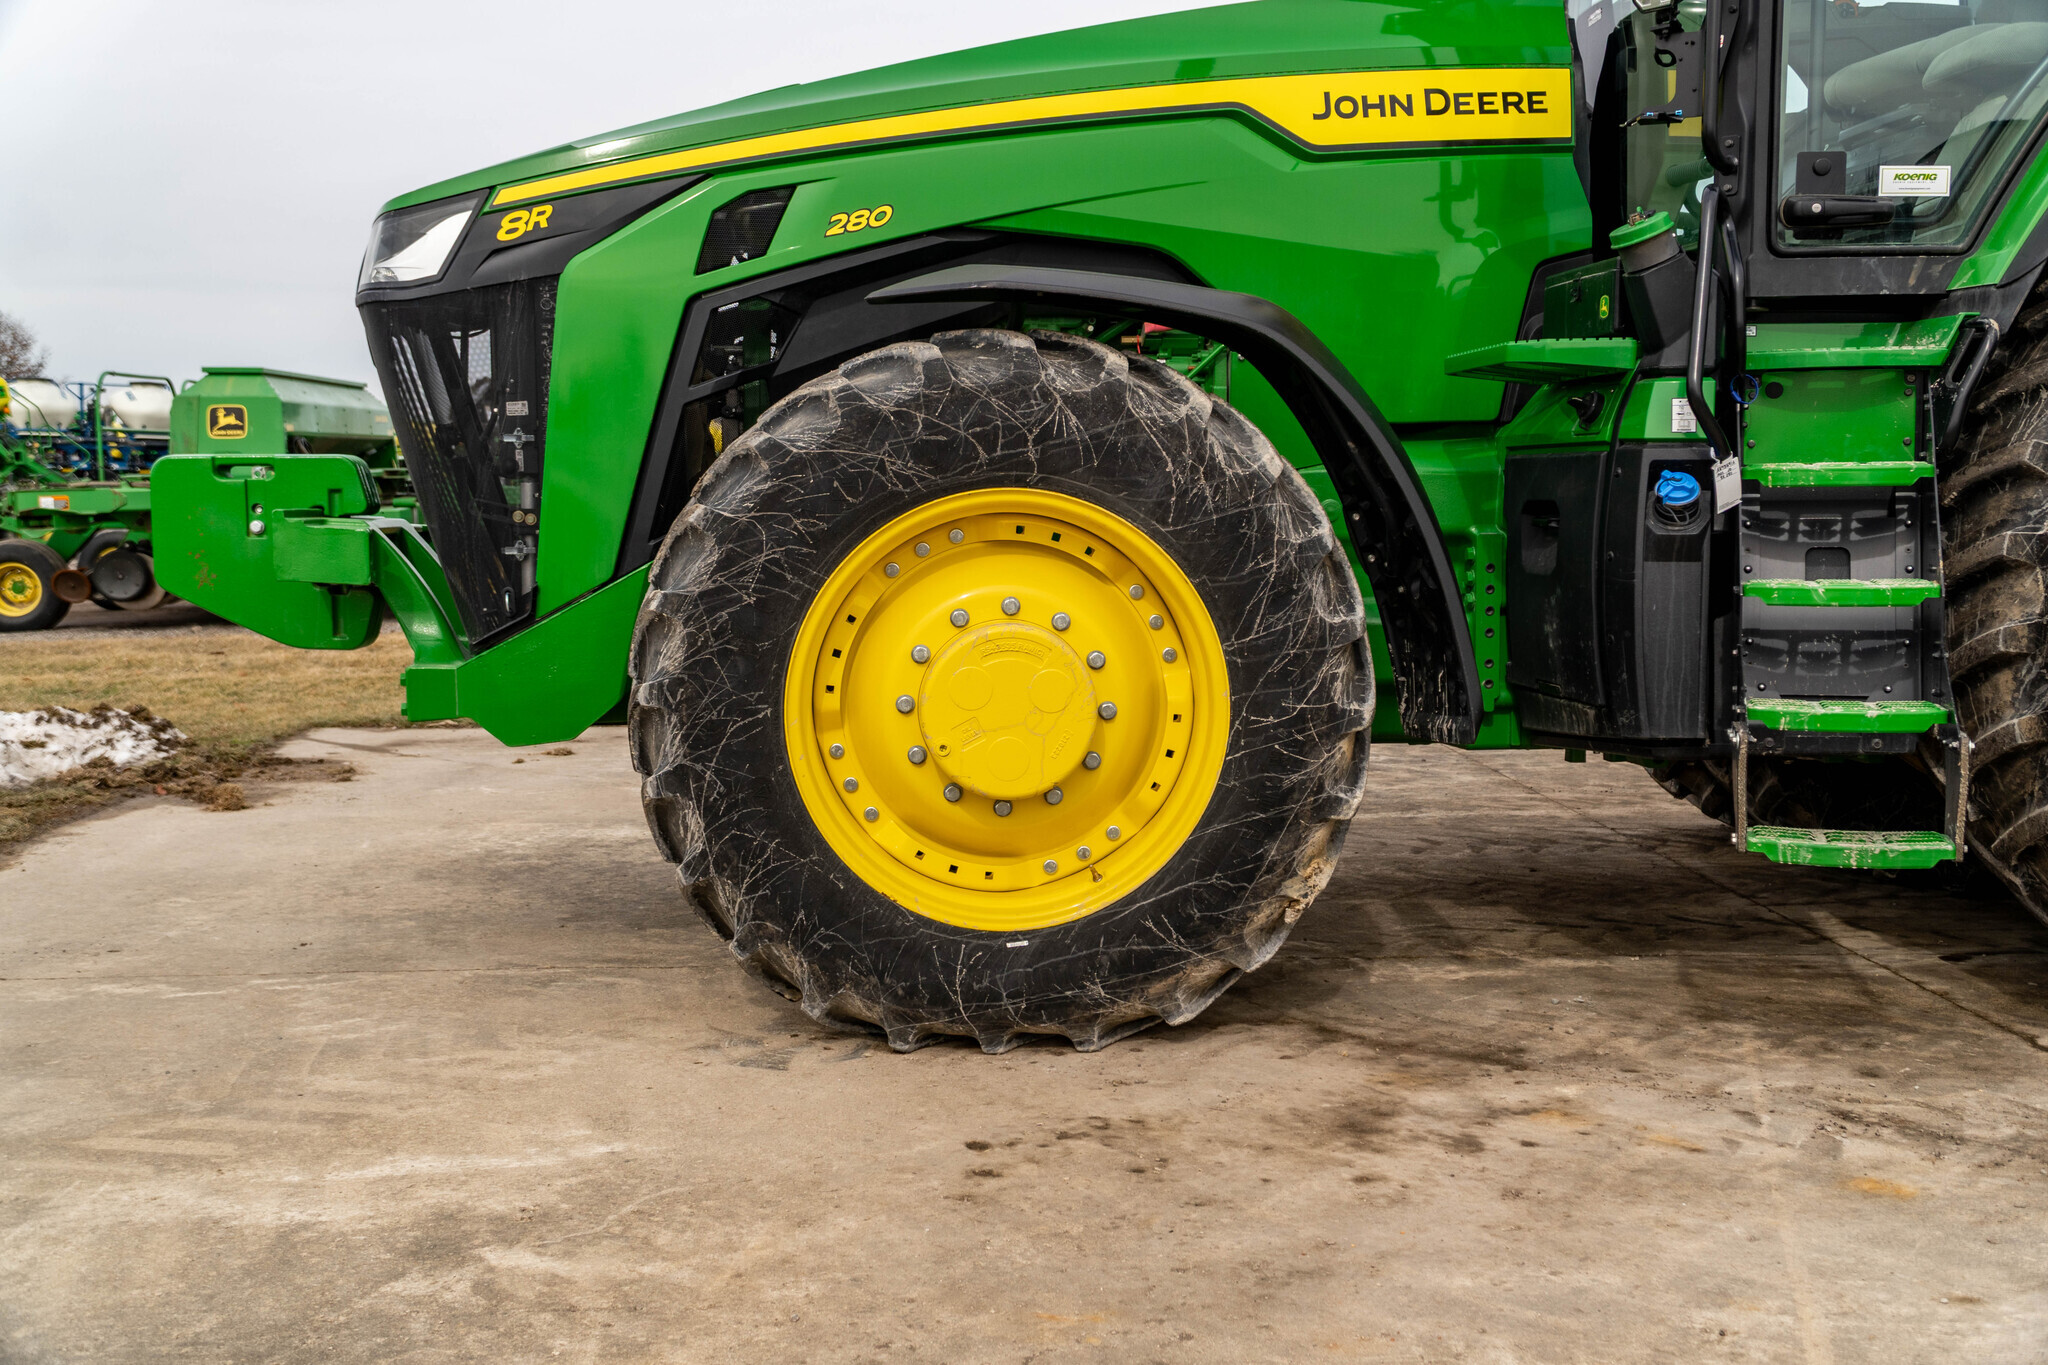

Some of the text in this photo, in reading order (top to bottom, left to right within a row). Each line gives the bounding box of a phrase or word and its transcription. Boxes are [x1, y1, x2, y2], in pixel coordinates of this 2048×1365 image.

[1312, 88, 1549, 120] JOHN DEERE
[496, 204, 553, 241] 8R
[824, 204, 894, 238] 280
